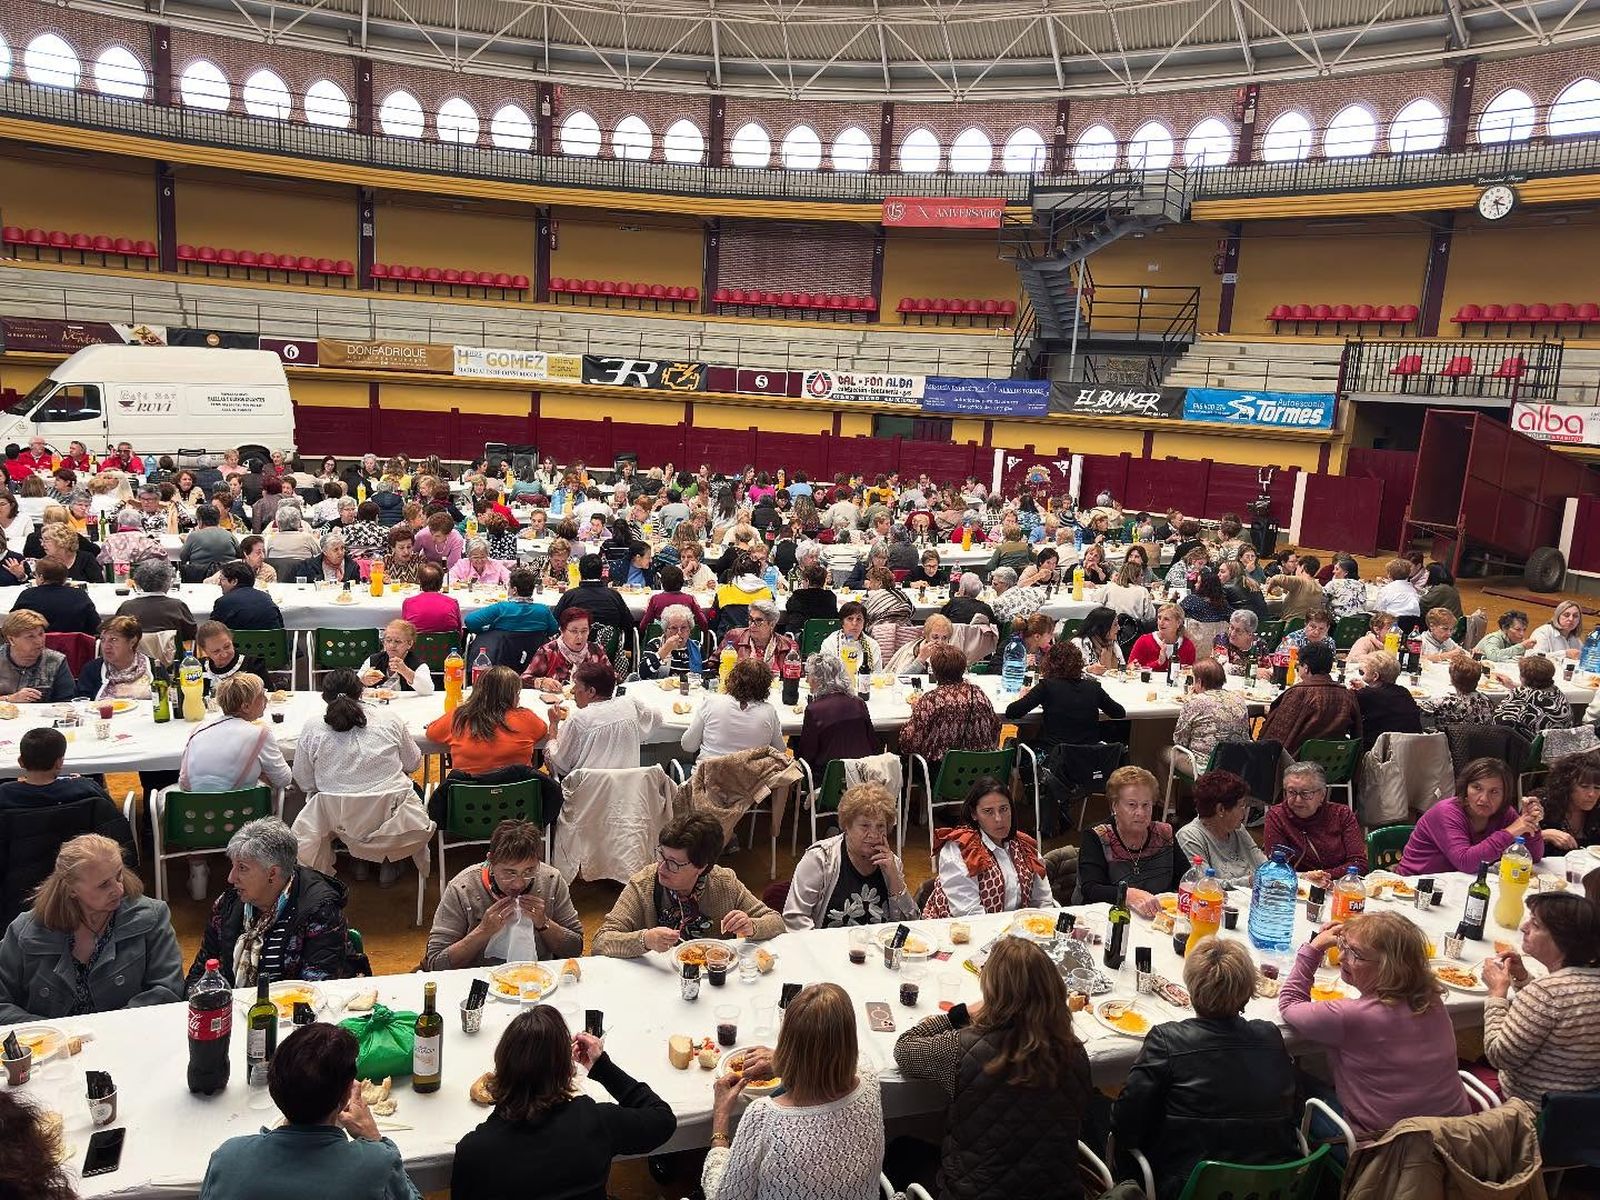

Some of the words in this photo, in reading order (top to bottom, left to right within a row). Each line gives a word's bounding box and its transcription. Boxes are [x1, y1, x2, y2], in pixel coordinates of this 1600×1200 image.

[160, 40, 168, 50] 3
[363, 72, 370, 82] 3
[1463, 77, 1471, 88] 2
[544, 94, 550, 103] 3
[1248, 98, 1255, 109] 2
[717, 108, 723, 118] 3
[1059, 112, 1065, 122] 3
[884, 114, 891, 124] 3
[164, 187, 171, 196] 6
[364, 208, 371, 218] 6
[937, 207, 1002, 219] ANIVERSARIO
[541, 226, 548, 235] 6
[347, 344, 427, 358] DONFADRIQUE
[486, 352, 544, 370] GOMEZ
[864, 376, 884, 387] FON
[886, 377, 913, 389] ALBA
[1074, 388, 1097, 405] EL
[1095, 388, 1161, 414] BUNKER
[1256, 399, 1325, 425] Tormes
[1518, 405, 1584, 434] alba
